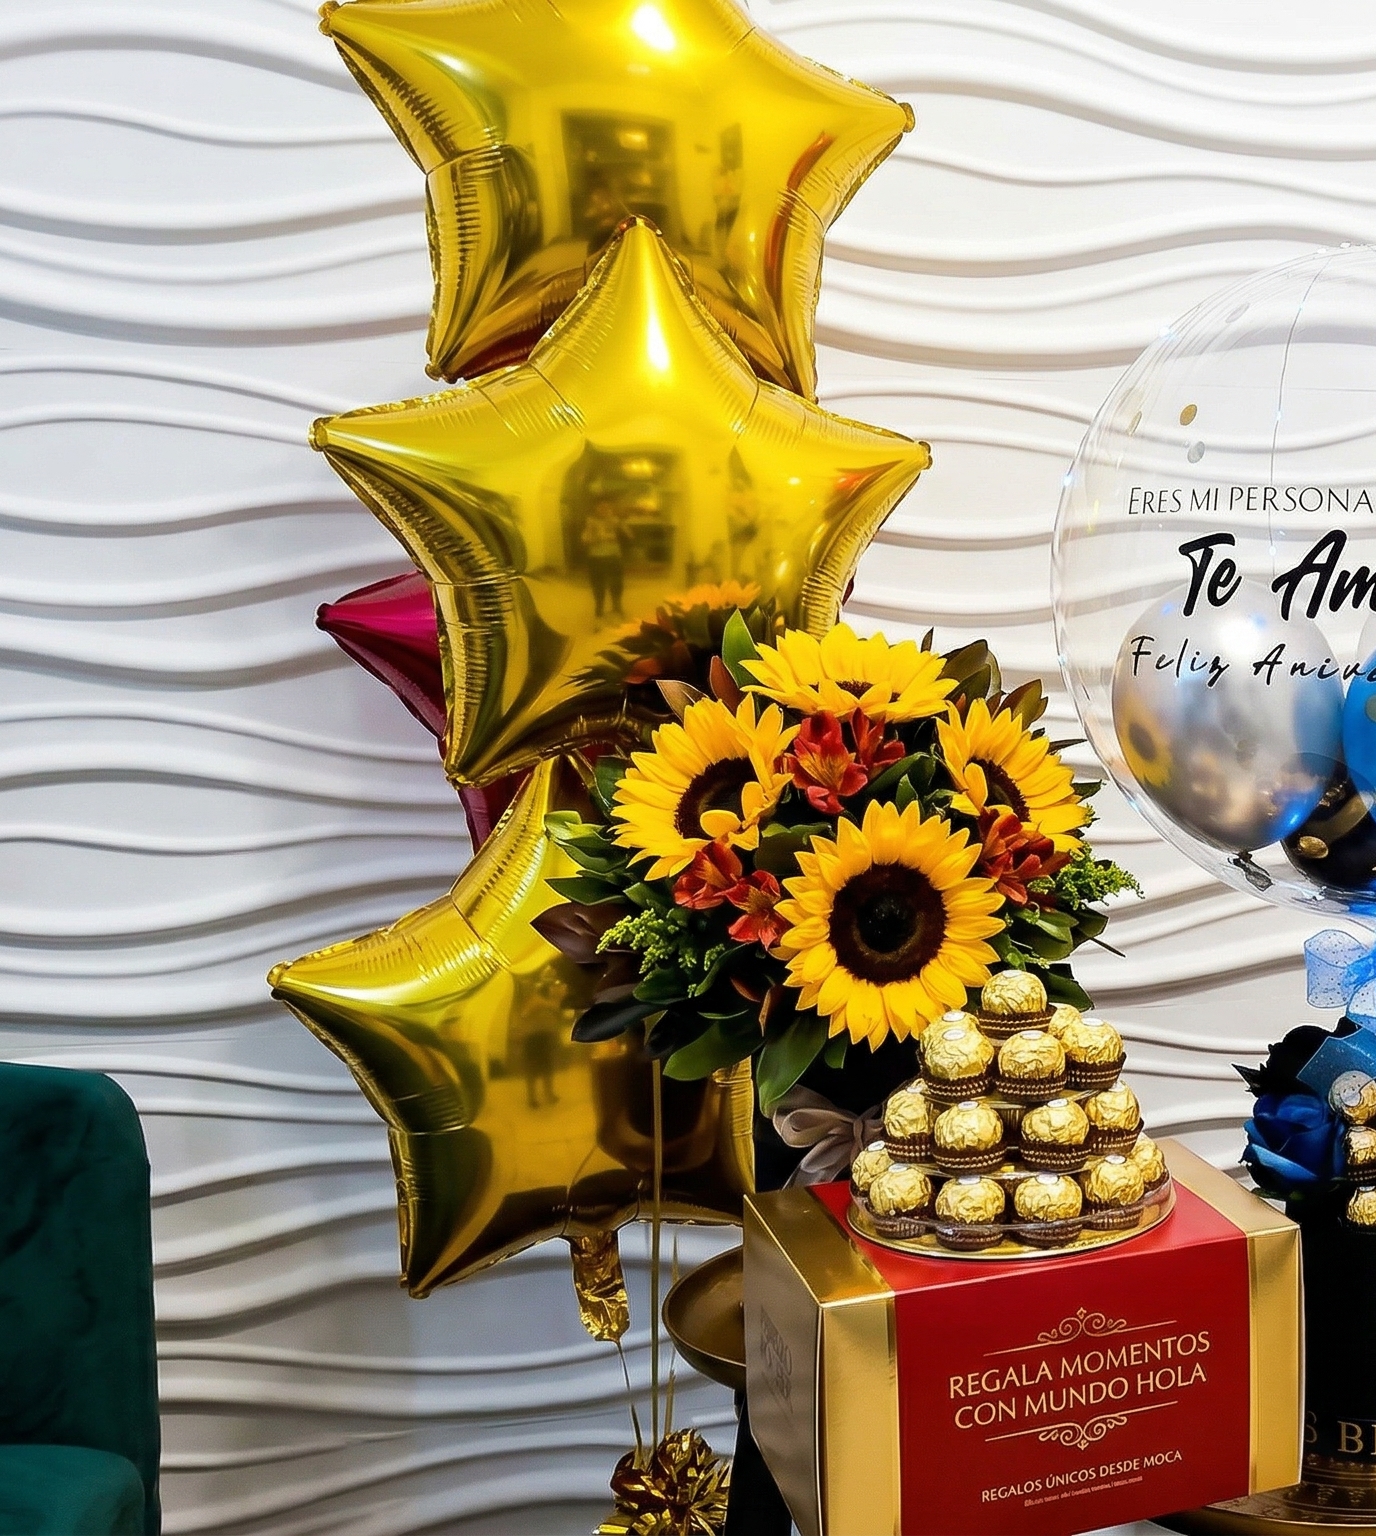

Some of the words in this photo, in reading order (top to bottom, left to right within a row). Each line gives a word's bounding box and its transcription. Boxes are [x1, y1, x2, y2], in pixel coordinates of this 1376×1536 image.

[1190, 487, 1219, 512] MI
[1229, 486, 1374, 513] PERSONA
[1179, 533, 1242, 617] Te
[1131, 635, 1230, 687] Feliz
[949, 1360, 1053, 1399] REGALA
[1060, 1331, 1210, 1379] MOMENTOS
[954, 1397, 1016, 1429] CON
[1024, 1376, 1129, 1417] MUNDO
[1136, 1362, 1207, 1395] HOLA
[981, 1478, 1043, 1503] REGALOS
[1045, 1467, 1097, 1489] ÚNICOS
[1099, 1458, 1140, 1478] DESDE
[1143, 1449, 1183, 1469] MOCA
